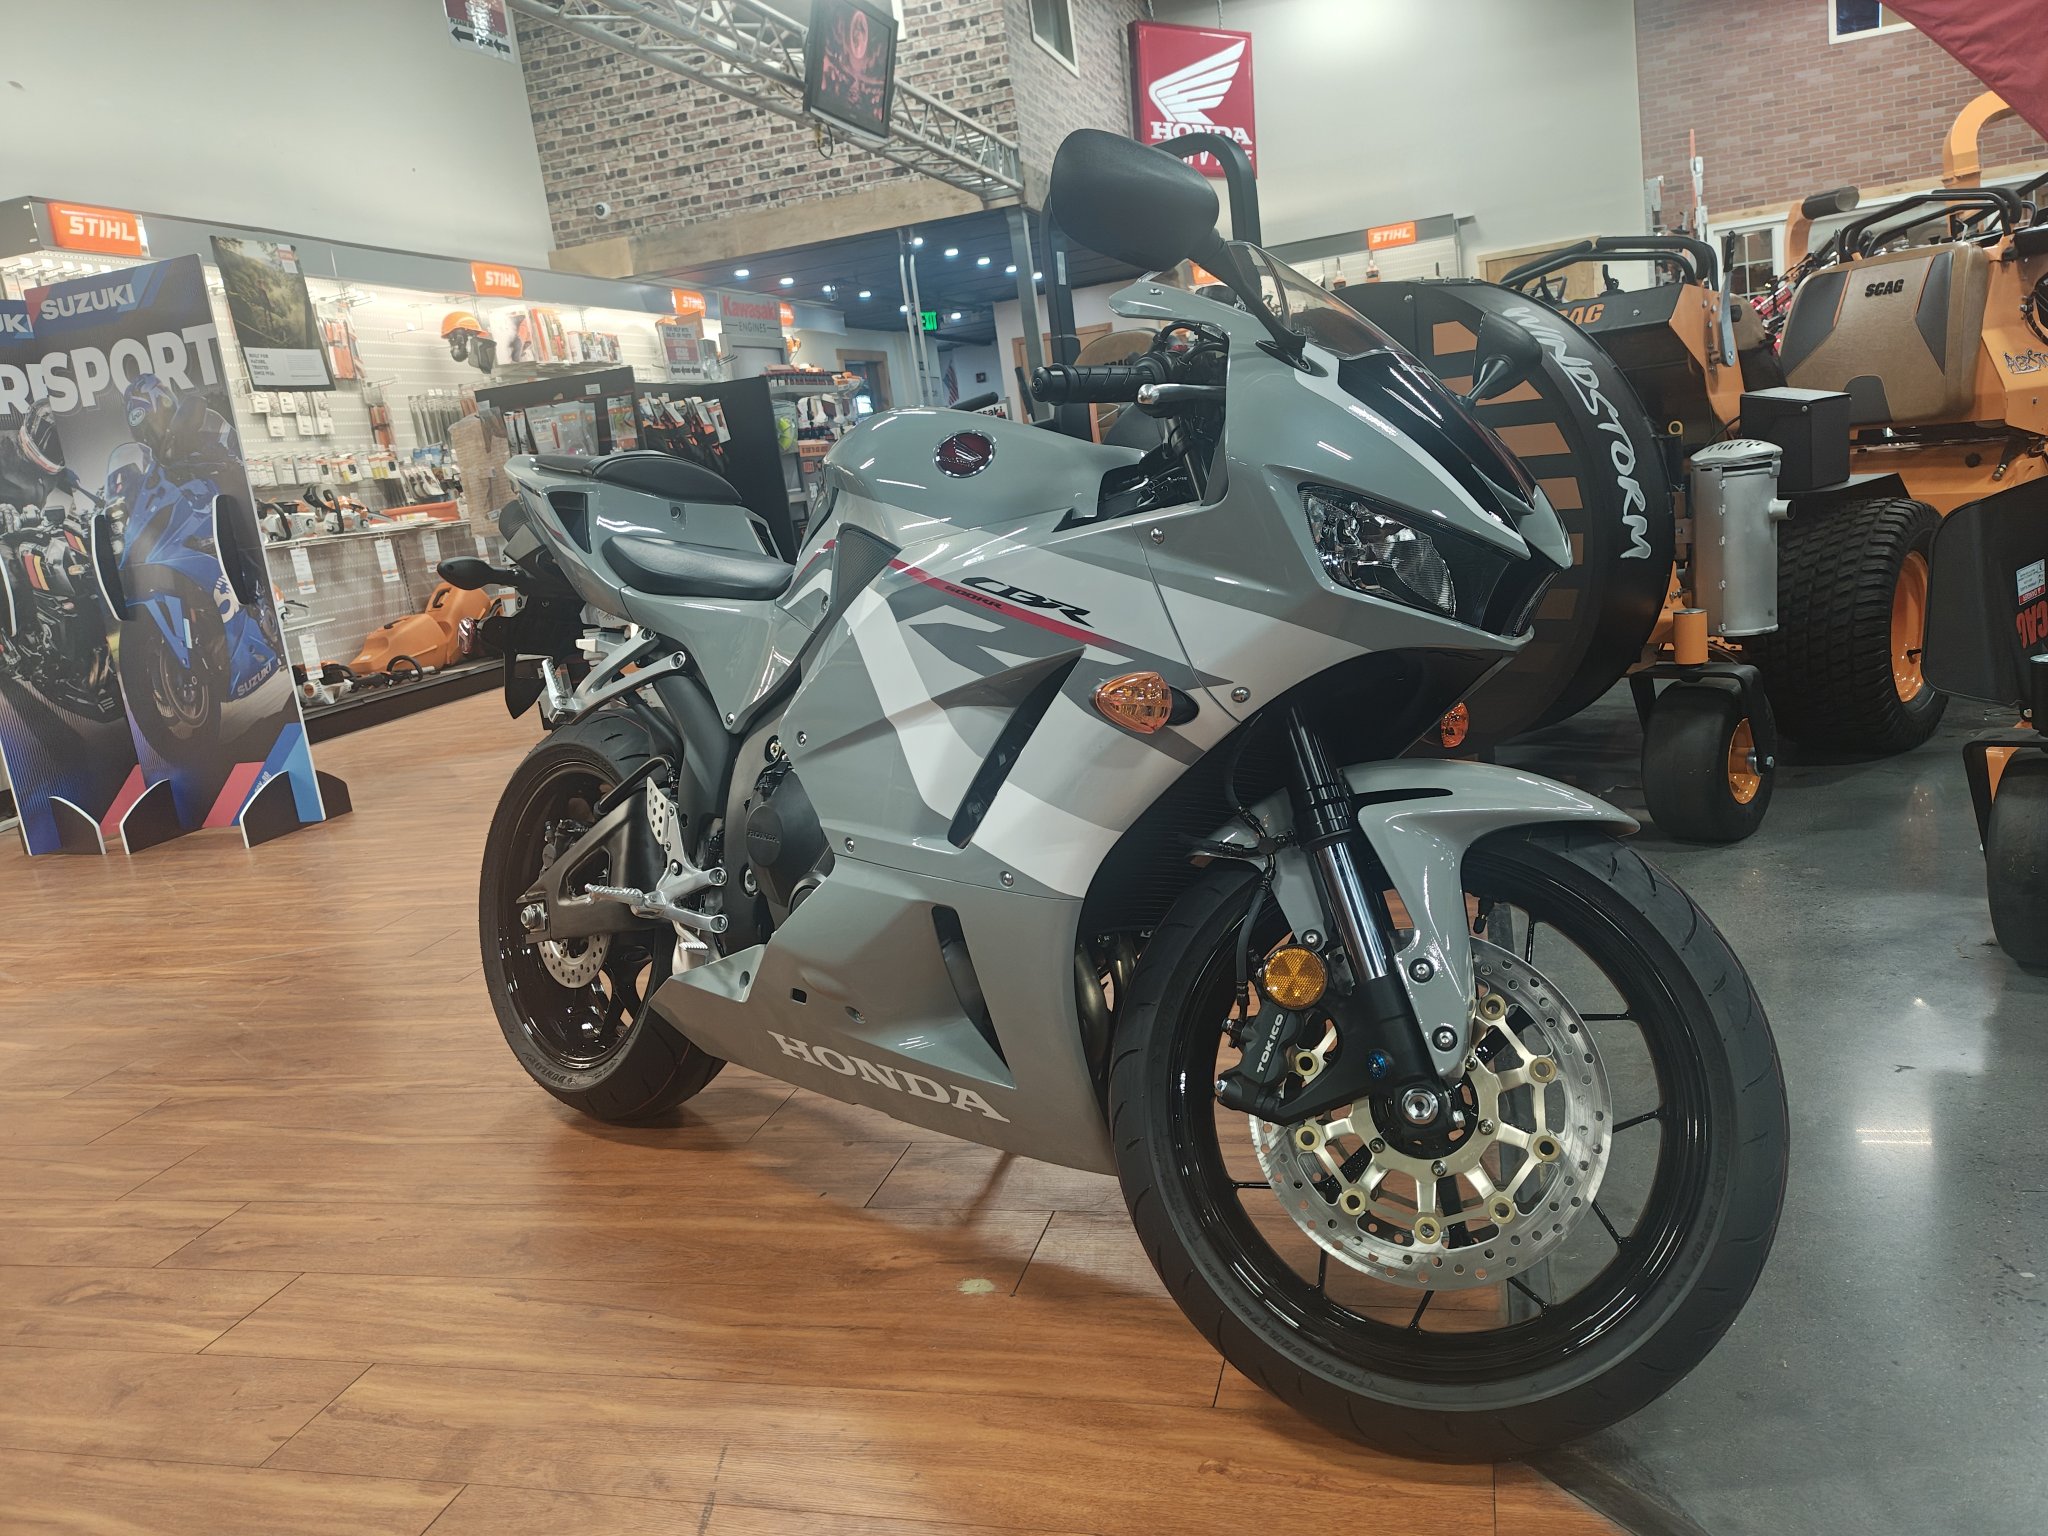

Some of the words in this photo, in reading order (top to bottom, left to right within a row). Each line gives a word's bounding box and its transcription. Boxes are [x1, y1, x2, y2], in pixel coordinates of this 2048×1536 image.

[68, 215, 136, 243] STIHL
[1372, 227, 1411, 244] STIHL
[484, 271, 520, 290] STIHL
[1865, 279, 1905, 298] SCAG
[41, 283, 136, 321] SUZUKI
[682, 296, 706, 310] STIHL
[722, 296, 778, 321] Kawasaki
[738, 321, 768, 334] ENGINES
[40, 323, 218, 413] SPORT
[1502, 307, 1652, 560] WINDSTORM
[960, 576, 1095, 628] CBR
[236, 662, 272, 697] SUZUKI
[1256, 1013, 1284, 1074] TOKICO
[767, 1030, 1010, 1123] HONDA
